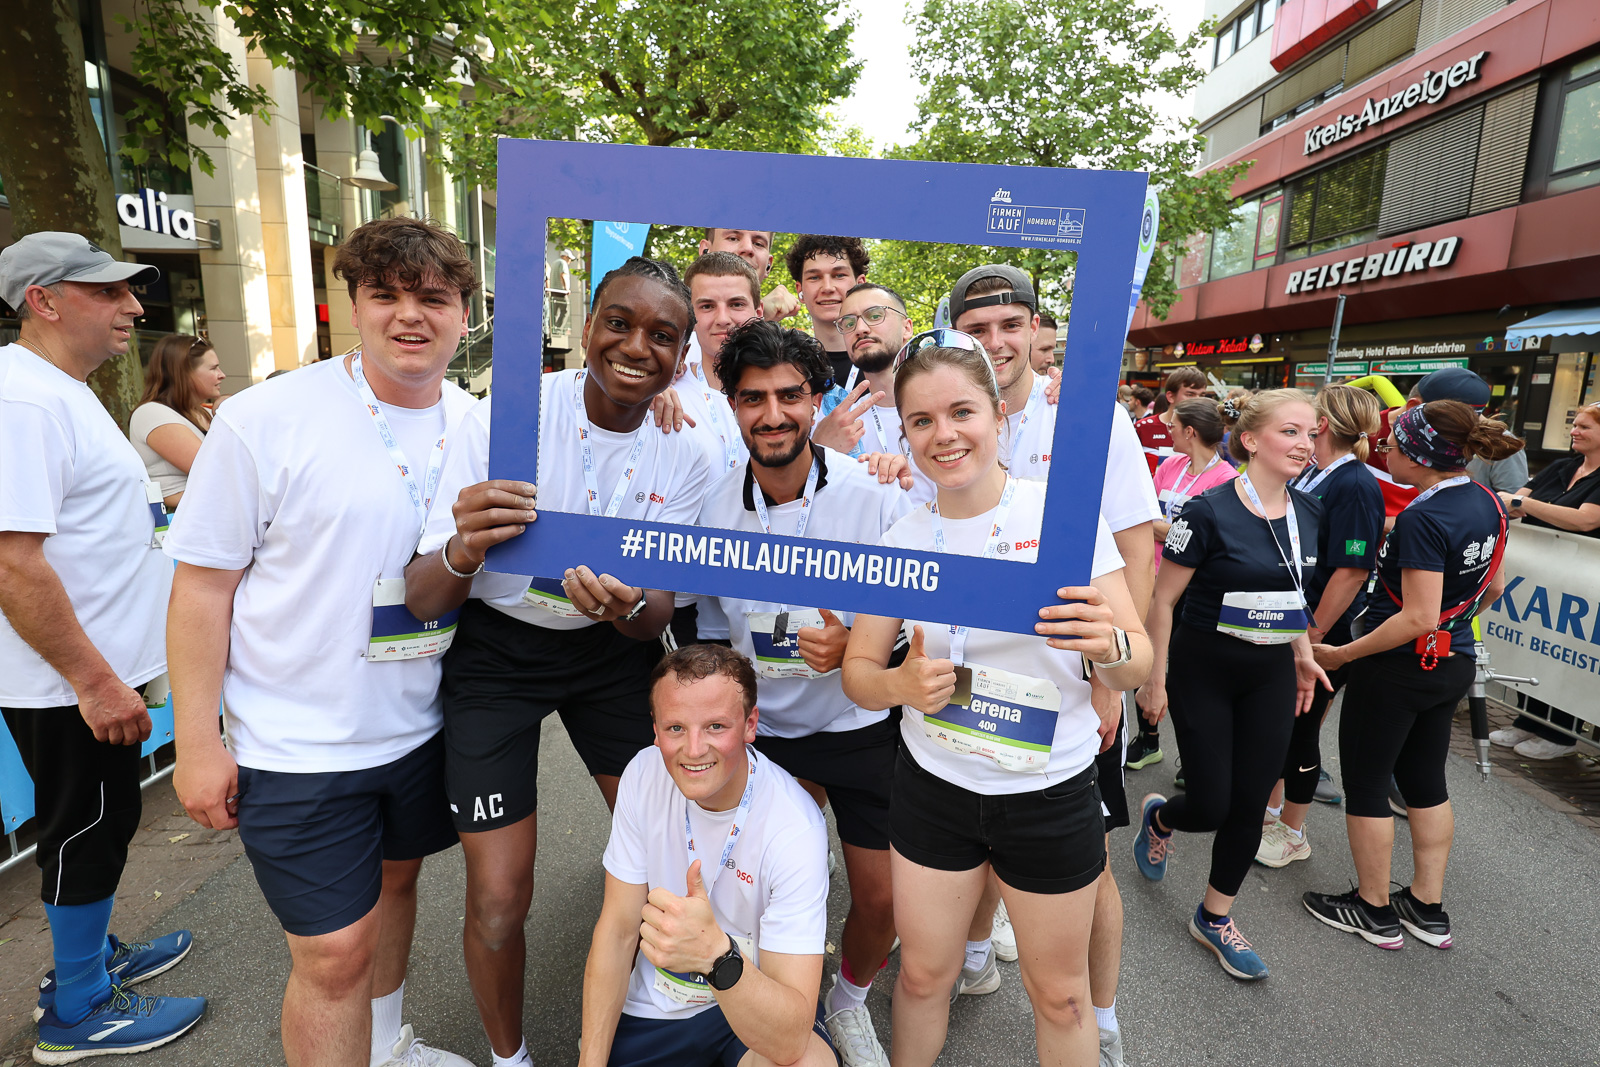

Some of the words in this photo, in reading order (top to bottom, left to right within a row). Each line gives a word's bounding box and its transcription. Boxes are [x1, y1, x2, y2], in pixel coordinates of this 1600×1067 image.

[1303, 51, 1486, 156] Kreis-Anzeiger
[994, 187, 1011, 199] dm
[116, 188, 197, 241] alia
[992, 208, 1022, 218] FIRMEN
[990, 217, 1021, 231] LAUF
[1026, 217, 1057, 226] HOMBURG
[1284, 236, 1459, 295] REISEBÜRO
[1216, 337, 1248, 354] Kebab
[1365, 346, 1385, 357] Hotel
[1385, 344, 1410, 356] Fähren
[1412, 342, 1466, 355] Kreuzfahrten
[401, 464, 409, 475] dm
[649, 492, 665, 504] OSCH
[620, 528, 941, 592] #FIRMENLAUFHOMBURG
[1247, 609, 1285, 621] Celine
[1490, 575, 1600, 645] KAR
[423, 620, 439, 630] 112
[790, 650, 801, 658] 30
[1487, 621, 1525, 647] ECHT.
[1529, 635, 1600, 675] BEGEIST
[978, 719, 997, 733] 400
[473, 792, 504, 821] AC
